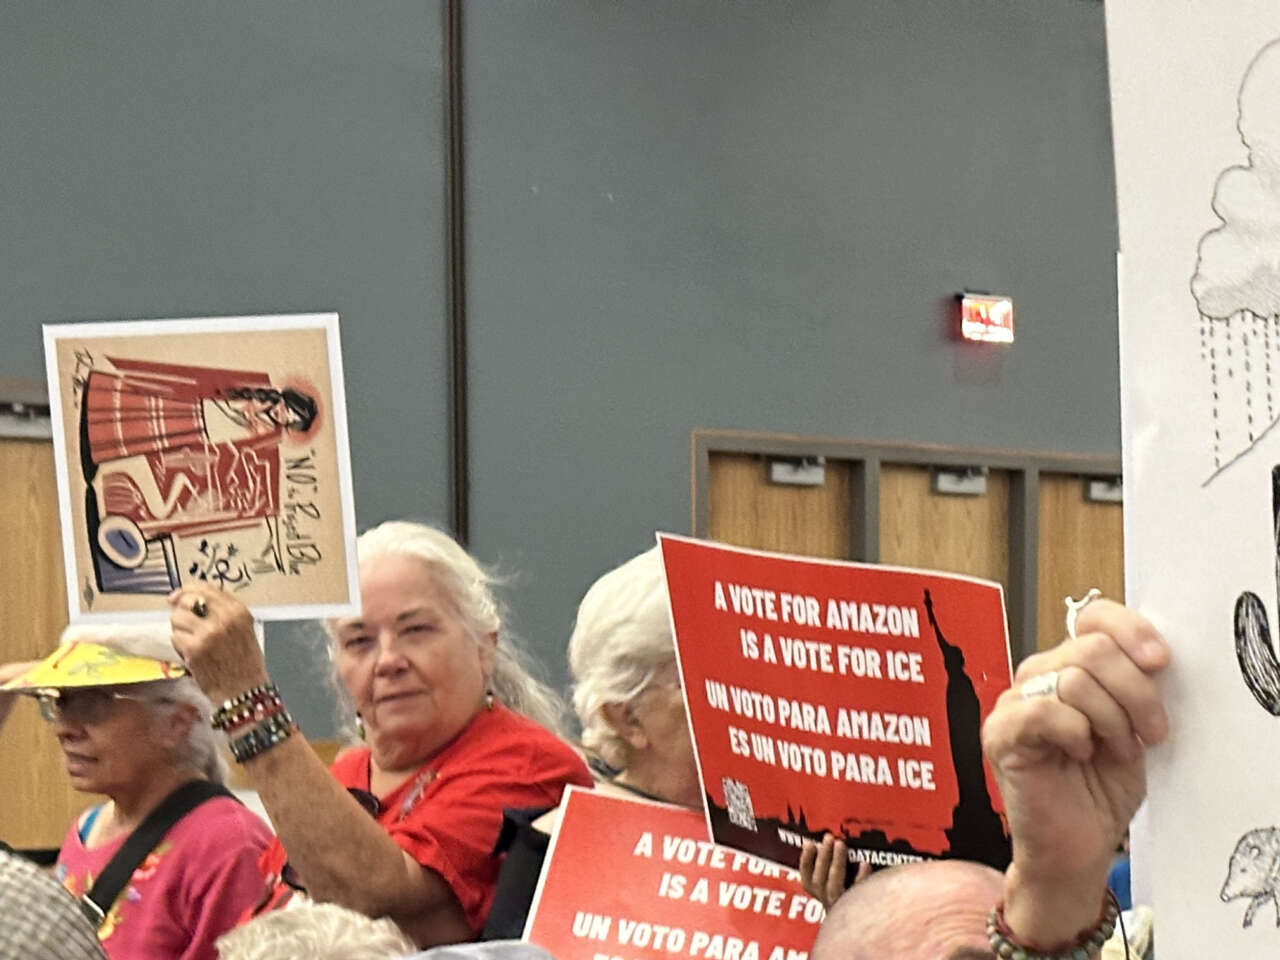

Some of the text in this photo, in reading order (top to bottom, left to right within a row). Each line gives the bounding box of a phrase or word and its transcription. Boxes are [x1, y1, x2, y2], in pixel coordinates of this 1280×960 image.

[714, 581, 920, 638] A VOTE FOR AMAZON
[740, 629, 925, 684] IS A VOTE FOR ICE
[705, 679, 932, 747] UN VOTO PARA AMAZON
[728, 725, 936, 791] ES UN VOTO PARA ICE
[634, 832, 653, 857] A
[663, 835, 726, 869] VOTE
[658, 872, 826, 924] IS A VOTE FO
[572, 911, 611, 942] UN
[617, 918, 687, 953] VOTO
